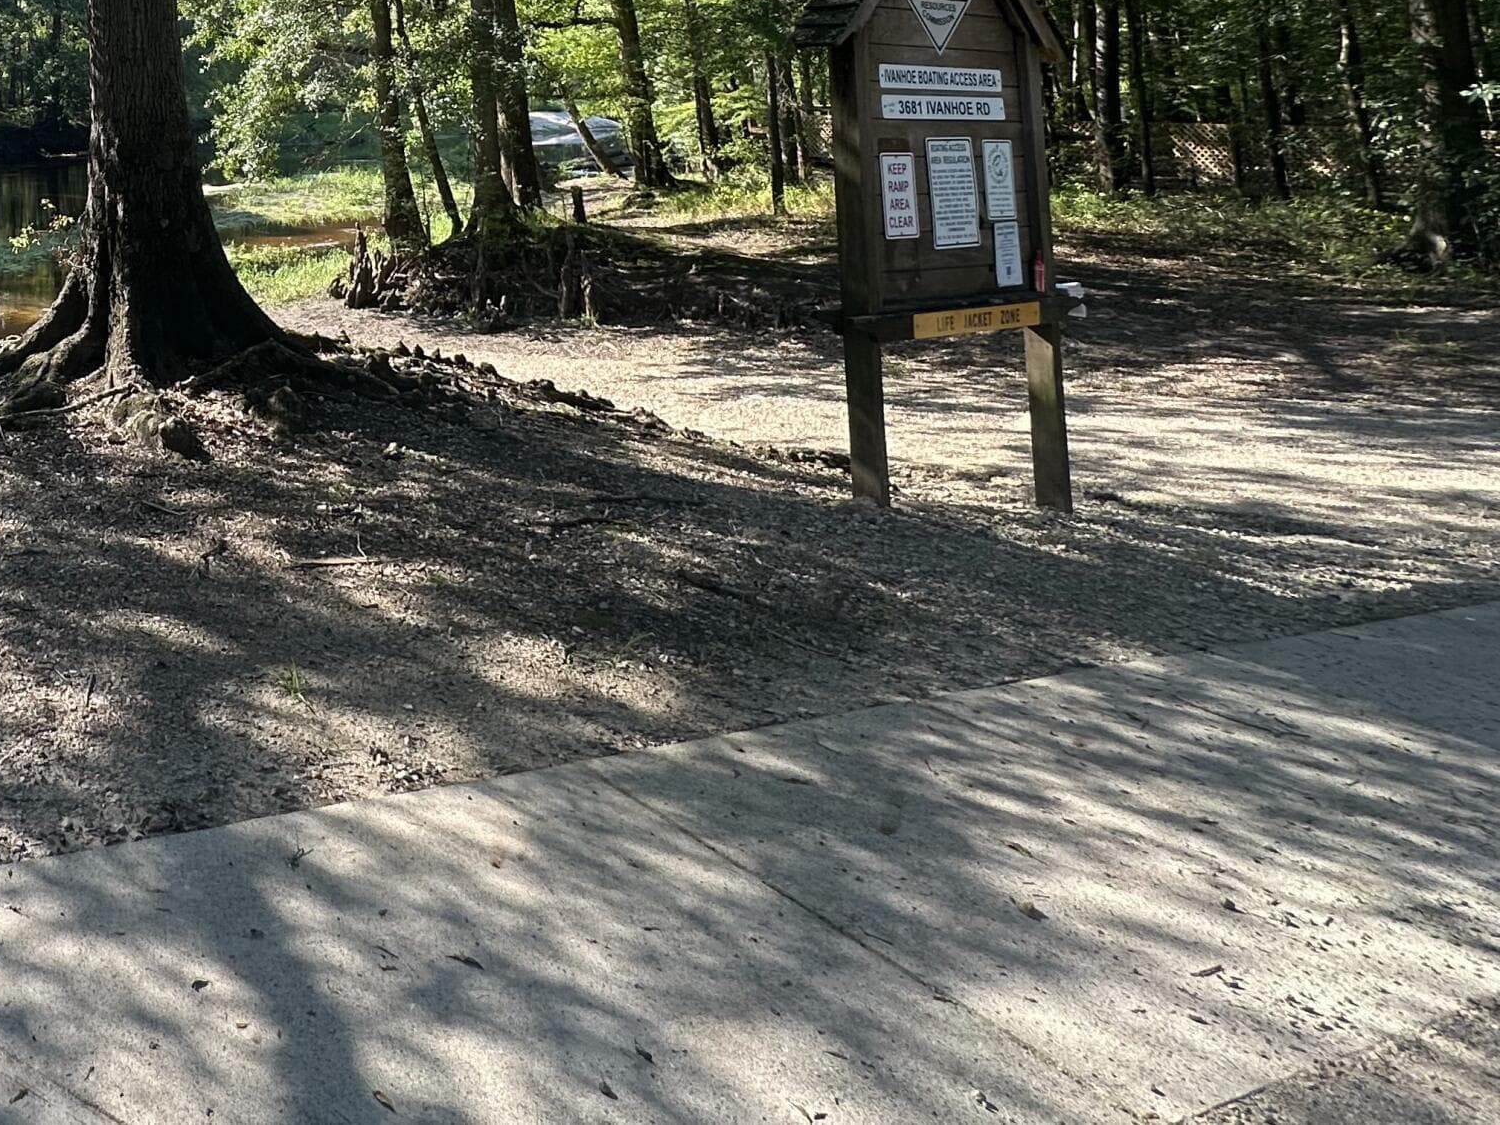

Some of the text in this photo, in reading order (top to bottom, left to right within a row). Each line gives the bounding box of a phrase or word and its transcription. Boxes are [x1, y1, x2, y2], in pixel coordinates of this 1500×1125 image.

[884, 69, 997, 87] IVANHOE BOATING ACCESS AREA
[898, 100, 922, 114] 3681
[926, 101, 974, 115] IVANHOE
[976, 102, 991, 115] RD
[888, 163, 906, 175] KEEP
[888, 181, 909, 192] RAMP
[890, 198, 910, 210] AREA
[889, 216, 914, 228] CLEAR
[936, 308, 1020, 332] LIFE JACKET ZONE
